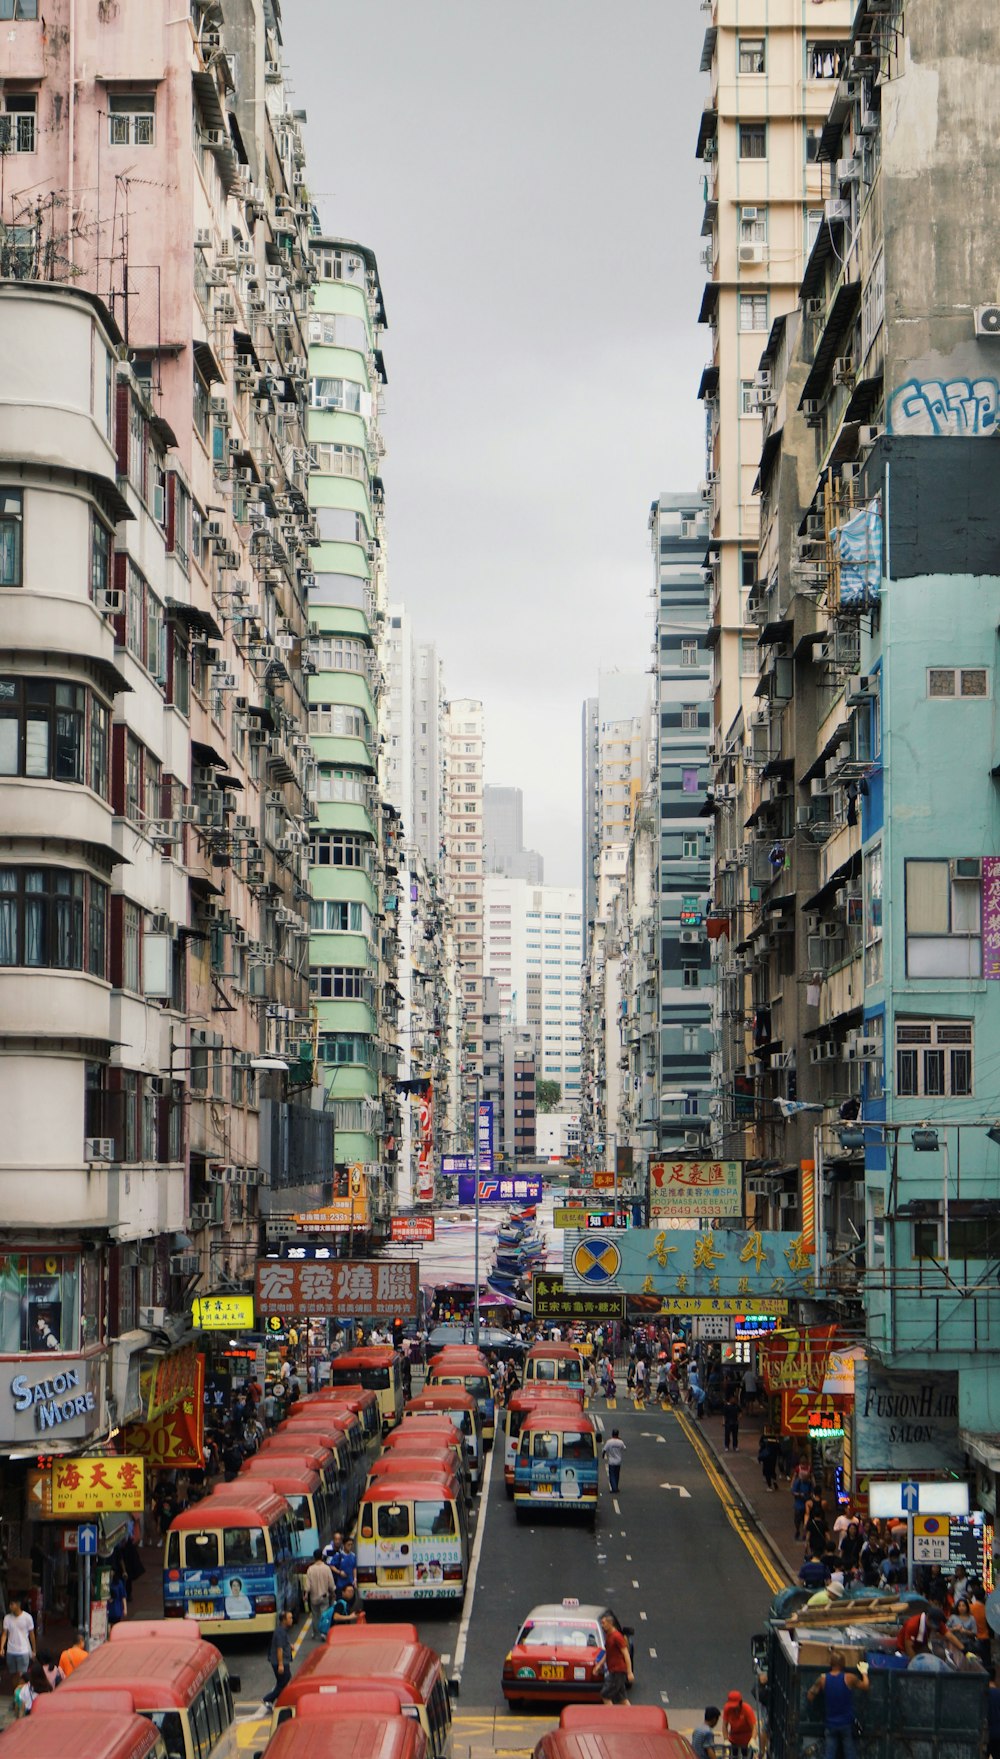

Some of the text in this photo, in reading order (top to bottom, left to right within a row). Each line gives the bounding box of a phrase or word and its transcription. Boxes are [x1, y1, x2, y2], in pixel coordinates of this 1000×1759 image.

[663, 1205, 740, 1215] 2649 4333 1/F
[672, 1198, 708, 1206] MASSAGE
[709, 1198, 738, 1206] BEAUTY
[259, 1263, 414, 1301] 宏發燒臘
[11, 1368, 82, 1411] SALON
[39, 1391, 96, 1431] MORE
[889, 1425, 933, 1443] SALON
[56, 1462, 142, 1491] 海天堂
[918, 1538, 945, 1546] 24 hrs
[920, 1548, 942, 1559] 全日
